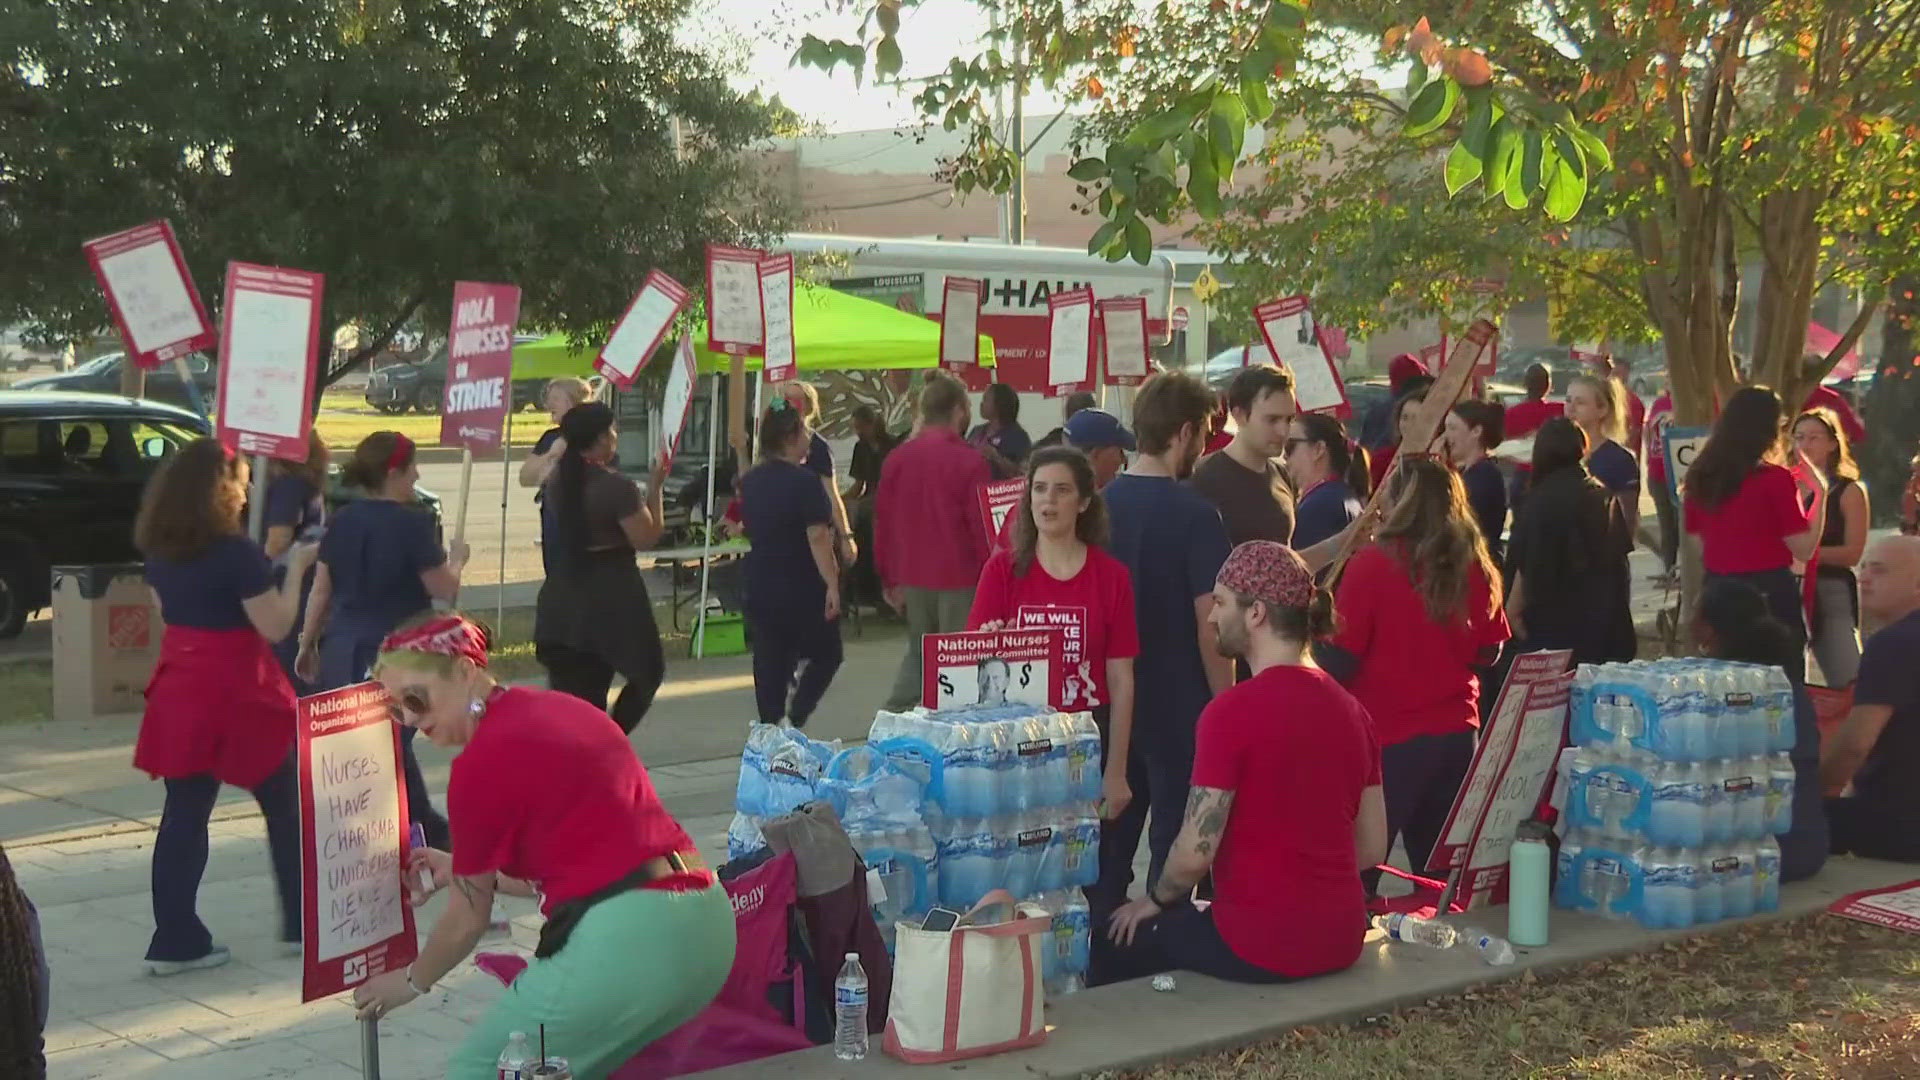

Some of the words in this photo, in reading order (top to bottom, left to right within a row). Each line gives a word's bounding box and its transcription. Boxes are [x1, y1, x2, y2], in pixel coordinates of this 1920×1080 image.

[873, 274, 921, 287] LOUISIANA
[456, 296, 495, 329] NOLA
[453, 323, 511, 359] NURSES
[446, 376, 505, 415] STRIKE
[986, 480, 1025, 496] National
[1024, 613, 1045, 624] WE
[1047, 613, 1080, 625] WILL
[937, 651, 993, 664] Organizing
[995, 647, 1050, 661] Committee
[938, 636, 998, 652] National
[1002, 633, 1050, 649] Nurses
[309, 692, 359, 718] National
[310, 712, 357, 733] Organizing
[321, 751, 381, 790] Nurses
[328, 788, 373, 823] HAVE
[323, 820, 396, 861] CHARISMA
